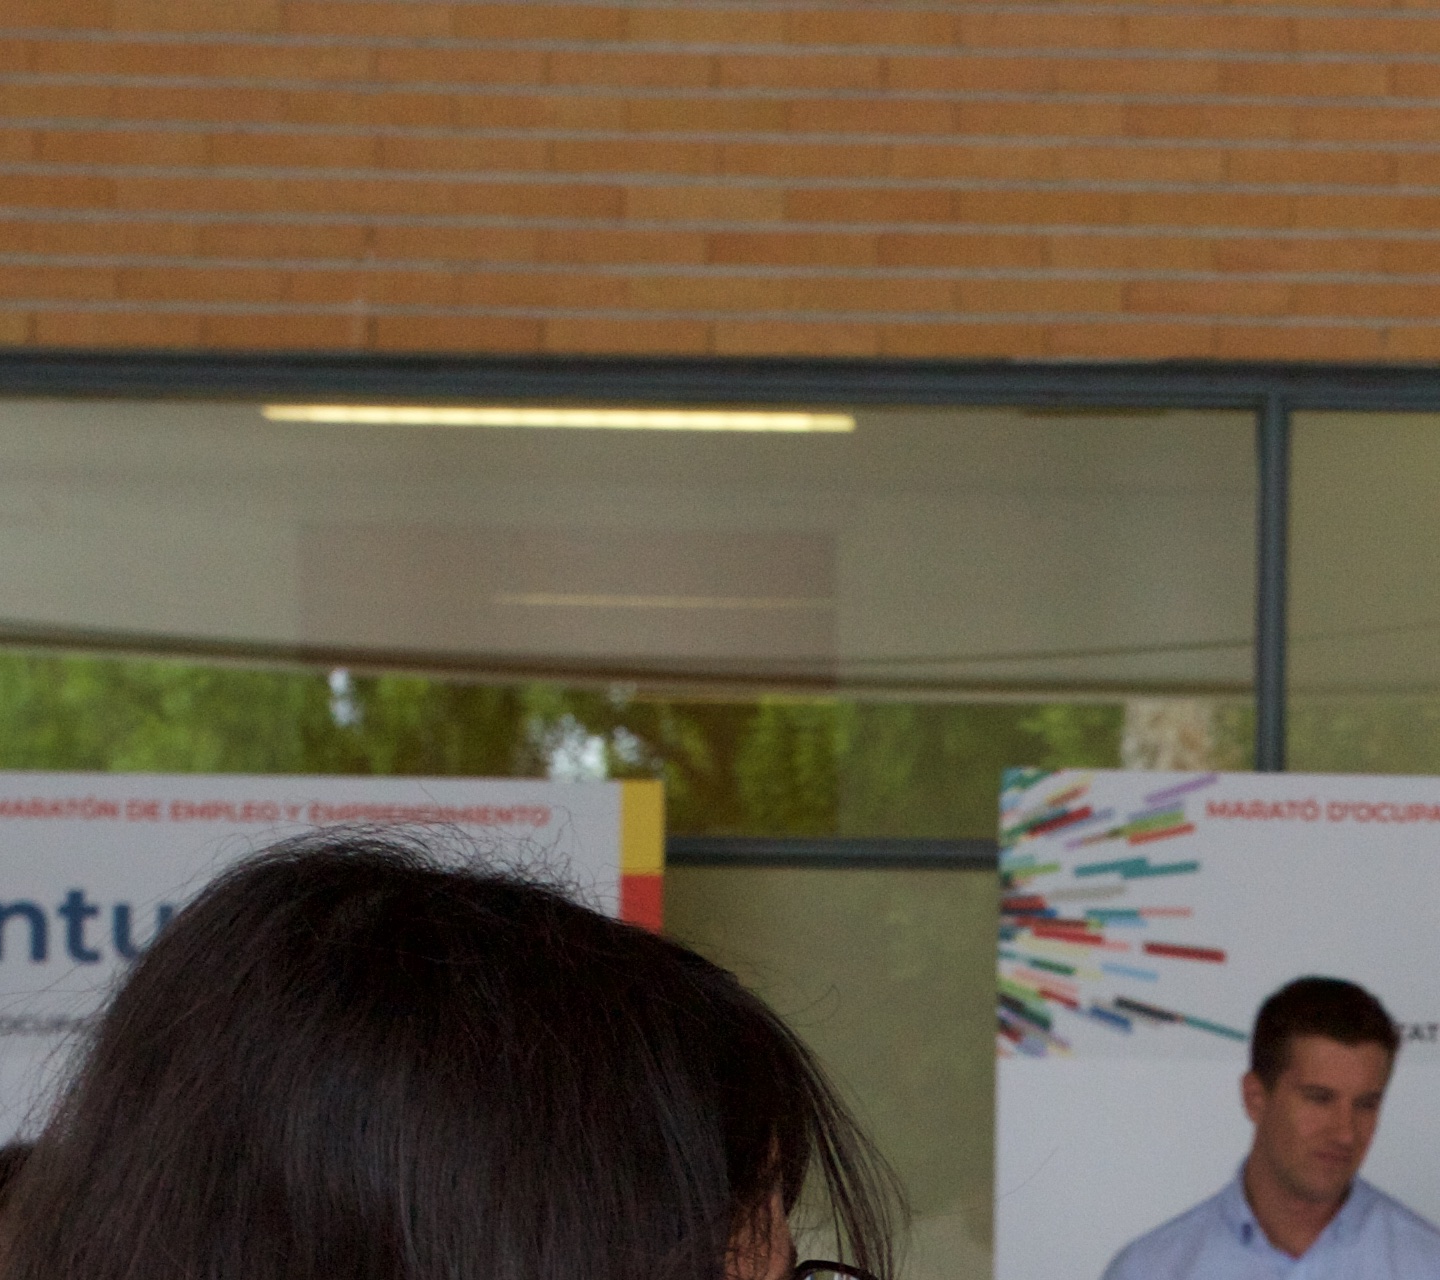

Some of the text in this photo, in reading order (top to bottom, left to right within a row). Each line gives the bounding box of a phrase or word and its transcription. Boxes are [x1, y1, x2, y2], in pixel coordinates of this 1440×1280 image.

[126, 799, 159, 822] DE
[169, 800, 280, 822] EMPLEO
[1205, 799, 1320, 822] MARATÓ
